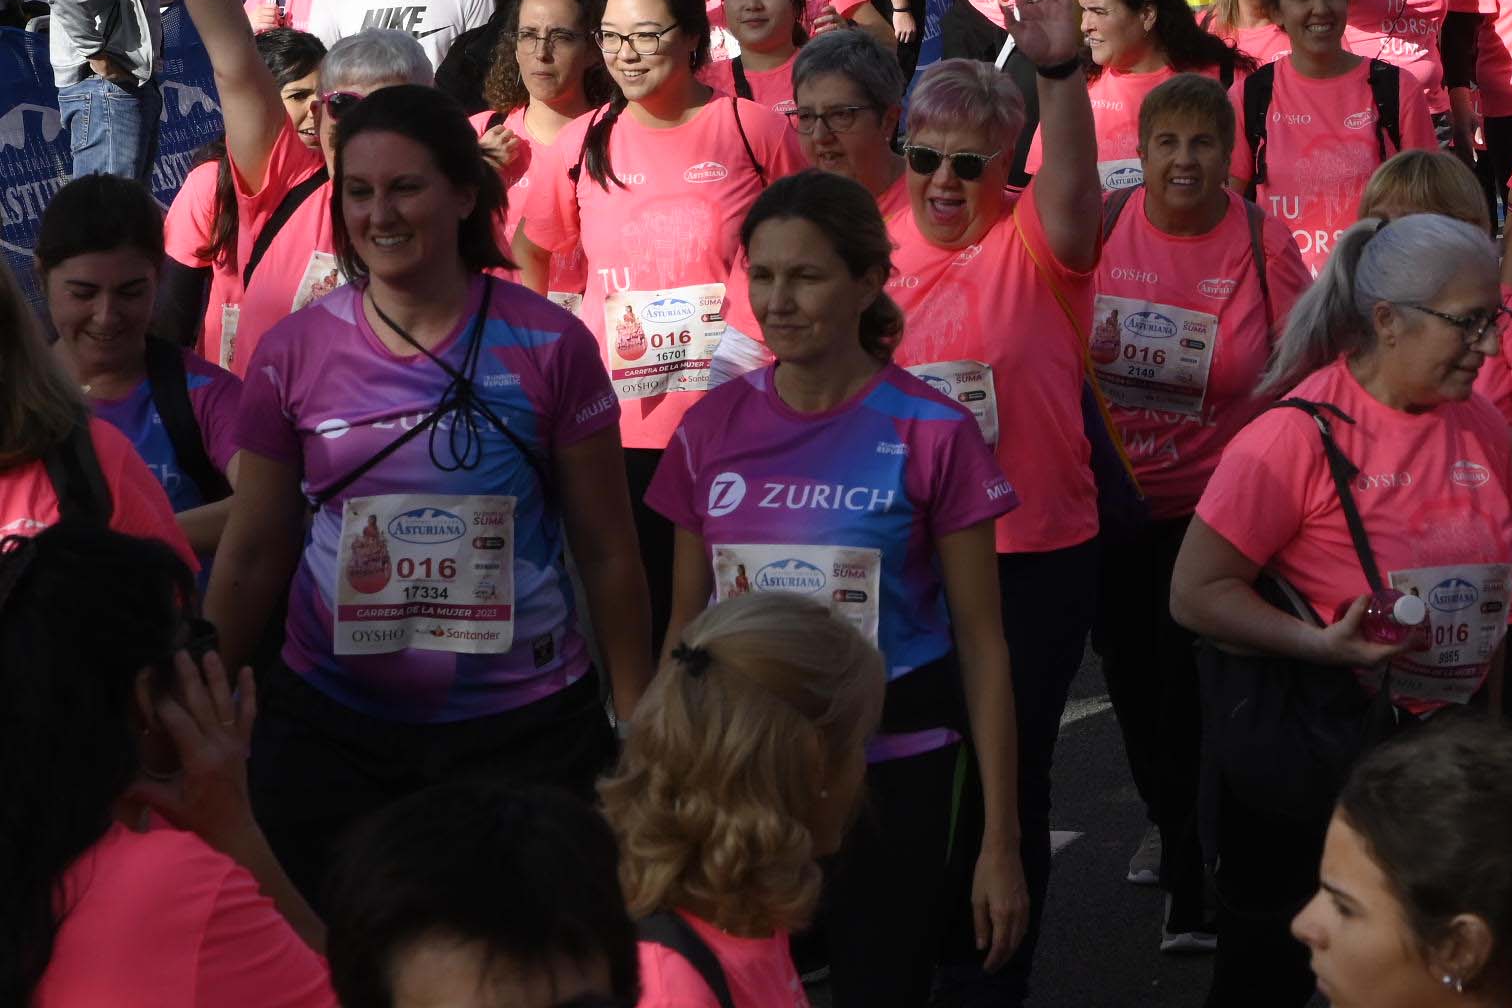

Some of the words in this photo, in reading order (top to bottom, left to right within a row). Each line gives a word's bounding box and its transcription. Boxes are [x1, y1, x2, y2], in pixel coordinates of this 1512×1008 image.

[362, 6, 427, 32] NIKE
[1269, 195, 1300, 219] TU
[597, 267, 631, 293] TU
[1111, 267, 1159, 284] OYSHO
[646, 307, 692, 318] ASTURIANA
[1128, 317, 1174, 335] ASTURIANA
[650, 330, 692, 348] 016
[656, 349, 687, 362] 16701
[1123, 344, 1167, 365] 016
[624, 367, 658, 377] CARRERA
[680, 361, 705, 370] MUJER
[1128, 365, 1155, 378] 2149
[955, 375, 983, 384] SUMA
[622, 381, 659, 394] OYSHO
[758, 483, 896, 512] ZURICH
[394, 521, 461, 536] ASTURIANA
[473, 517, 505, 526] SUMA
[397, 557, 457, 579] 016
[833, 569, 866, 579] SUMA
[760, 571, 821, 587] ASTURIANA
[402, 586, 449, 600] 17334
[357, 608, 404, 618] CARRERA
[406, 606, 418, 614] DE
[421, 606, 434, 615] LA
[437, 608, 472, 618] MUJER
[475, 608, 497, 617] 2023
[352, 629, 405, 643] OYSHO
[446, 629, 501, 641] Santander
[1435, 624, 1469, 645] 016
